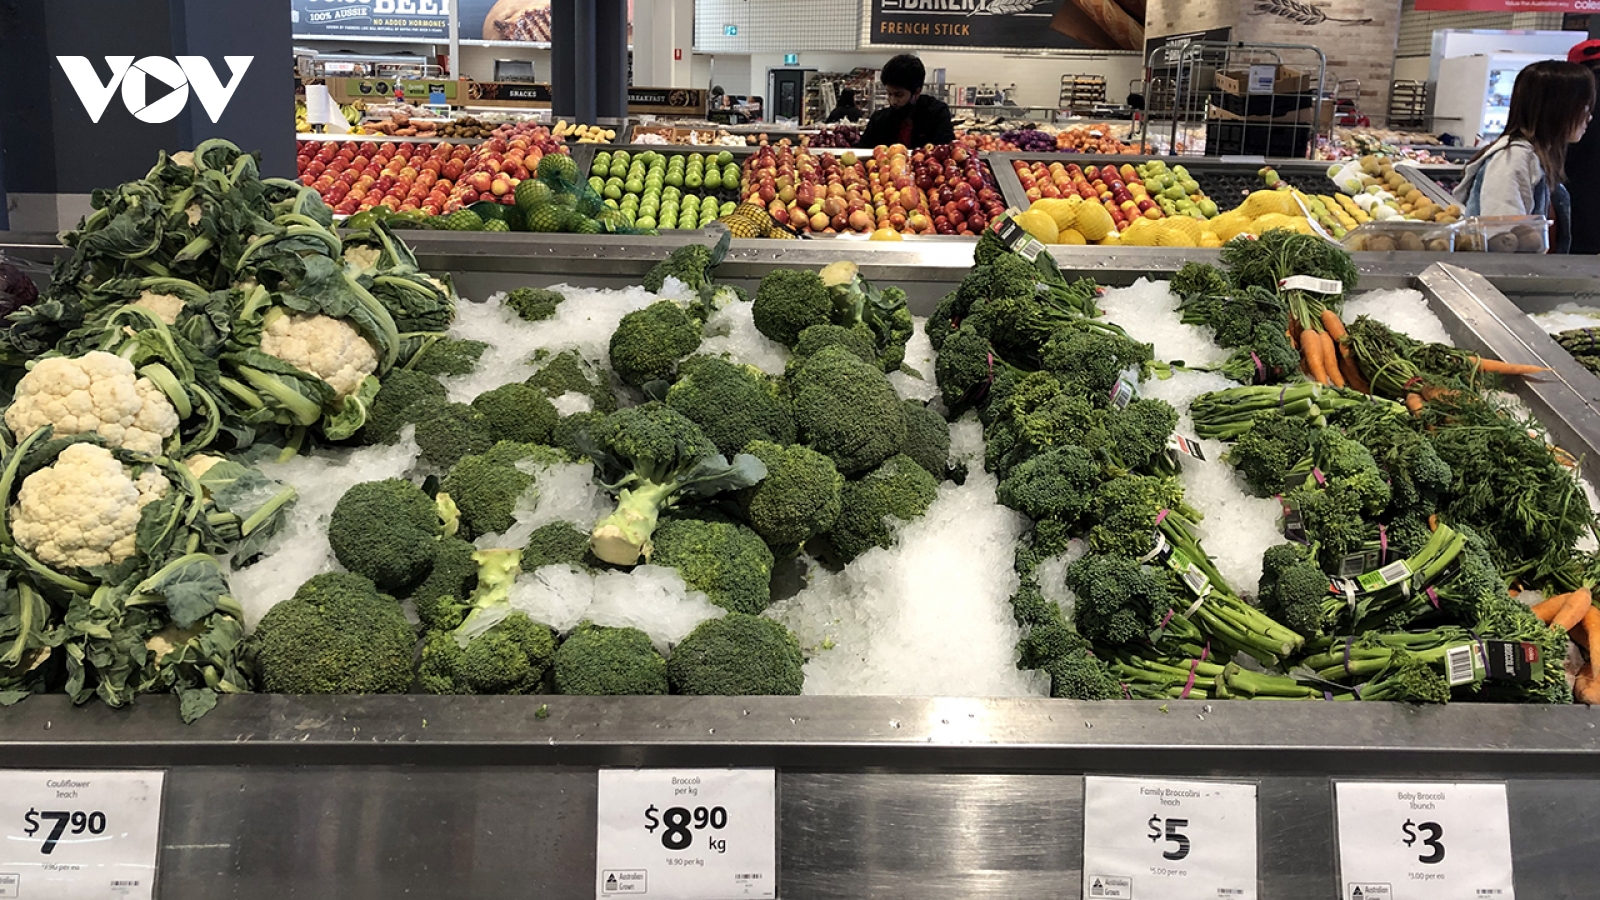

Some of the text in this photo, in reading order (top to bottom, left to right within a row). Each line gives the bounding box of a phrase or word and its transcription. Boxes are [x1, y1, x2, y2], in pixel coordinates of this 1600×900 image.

[310, 8, 368, 21] 100% AUSSIE
[385, 19, 407, 27] ADDED
[408, 20, 445, 28] HORMONES
[880, 21, 970, 36] FRENCH STICK
[509, 90, 537, 98] SNACKS
[46, 779, 90, 789] Cauliflower
[672, 776, 701, 785] Broccoli
[674, 786, 698, 797] per kg
[1140, 787, 1201, 798] Family Broccolini
[1397, 792, 1445, 801] Baby Broccoli
[1147, 813, 1190, 861] $5
[1402, 818, 1446, 864] $3
[709, 836, 727, 854] kg
[684, 859, 695, 867] per
[695, 858, 704, 867] kg
[619, 872, 644, 881] Australian
[1167, 869, 1178, 877] per
[619, 882, 635, 891] Grown
[1104, 879, 1128, 887] Australian
[1104, 888, 1120, 896] Grown
[1365, 886, 1388, 894] Australian
